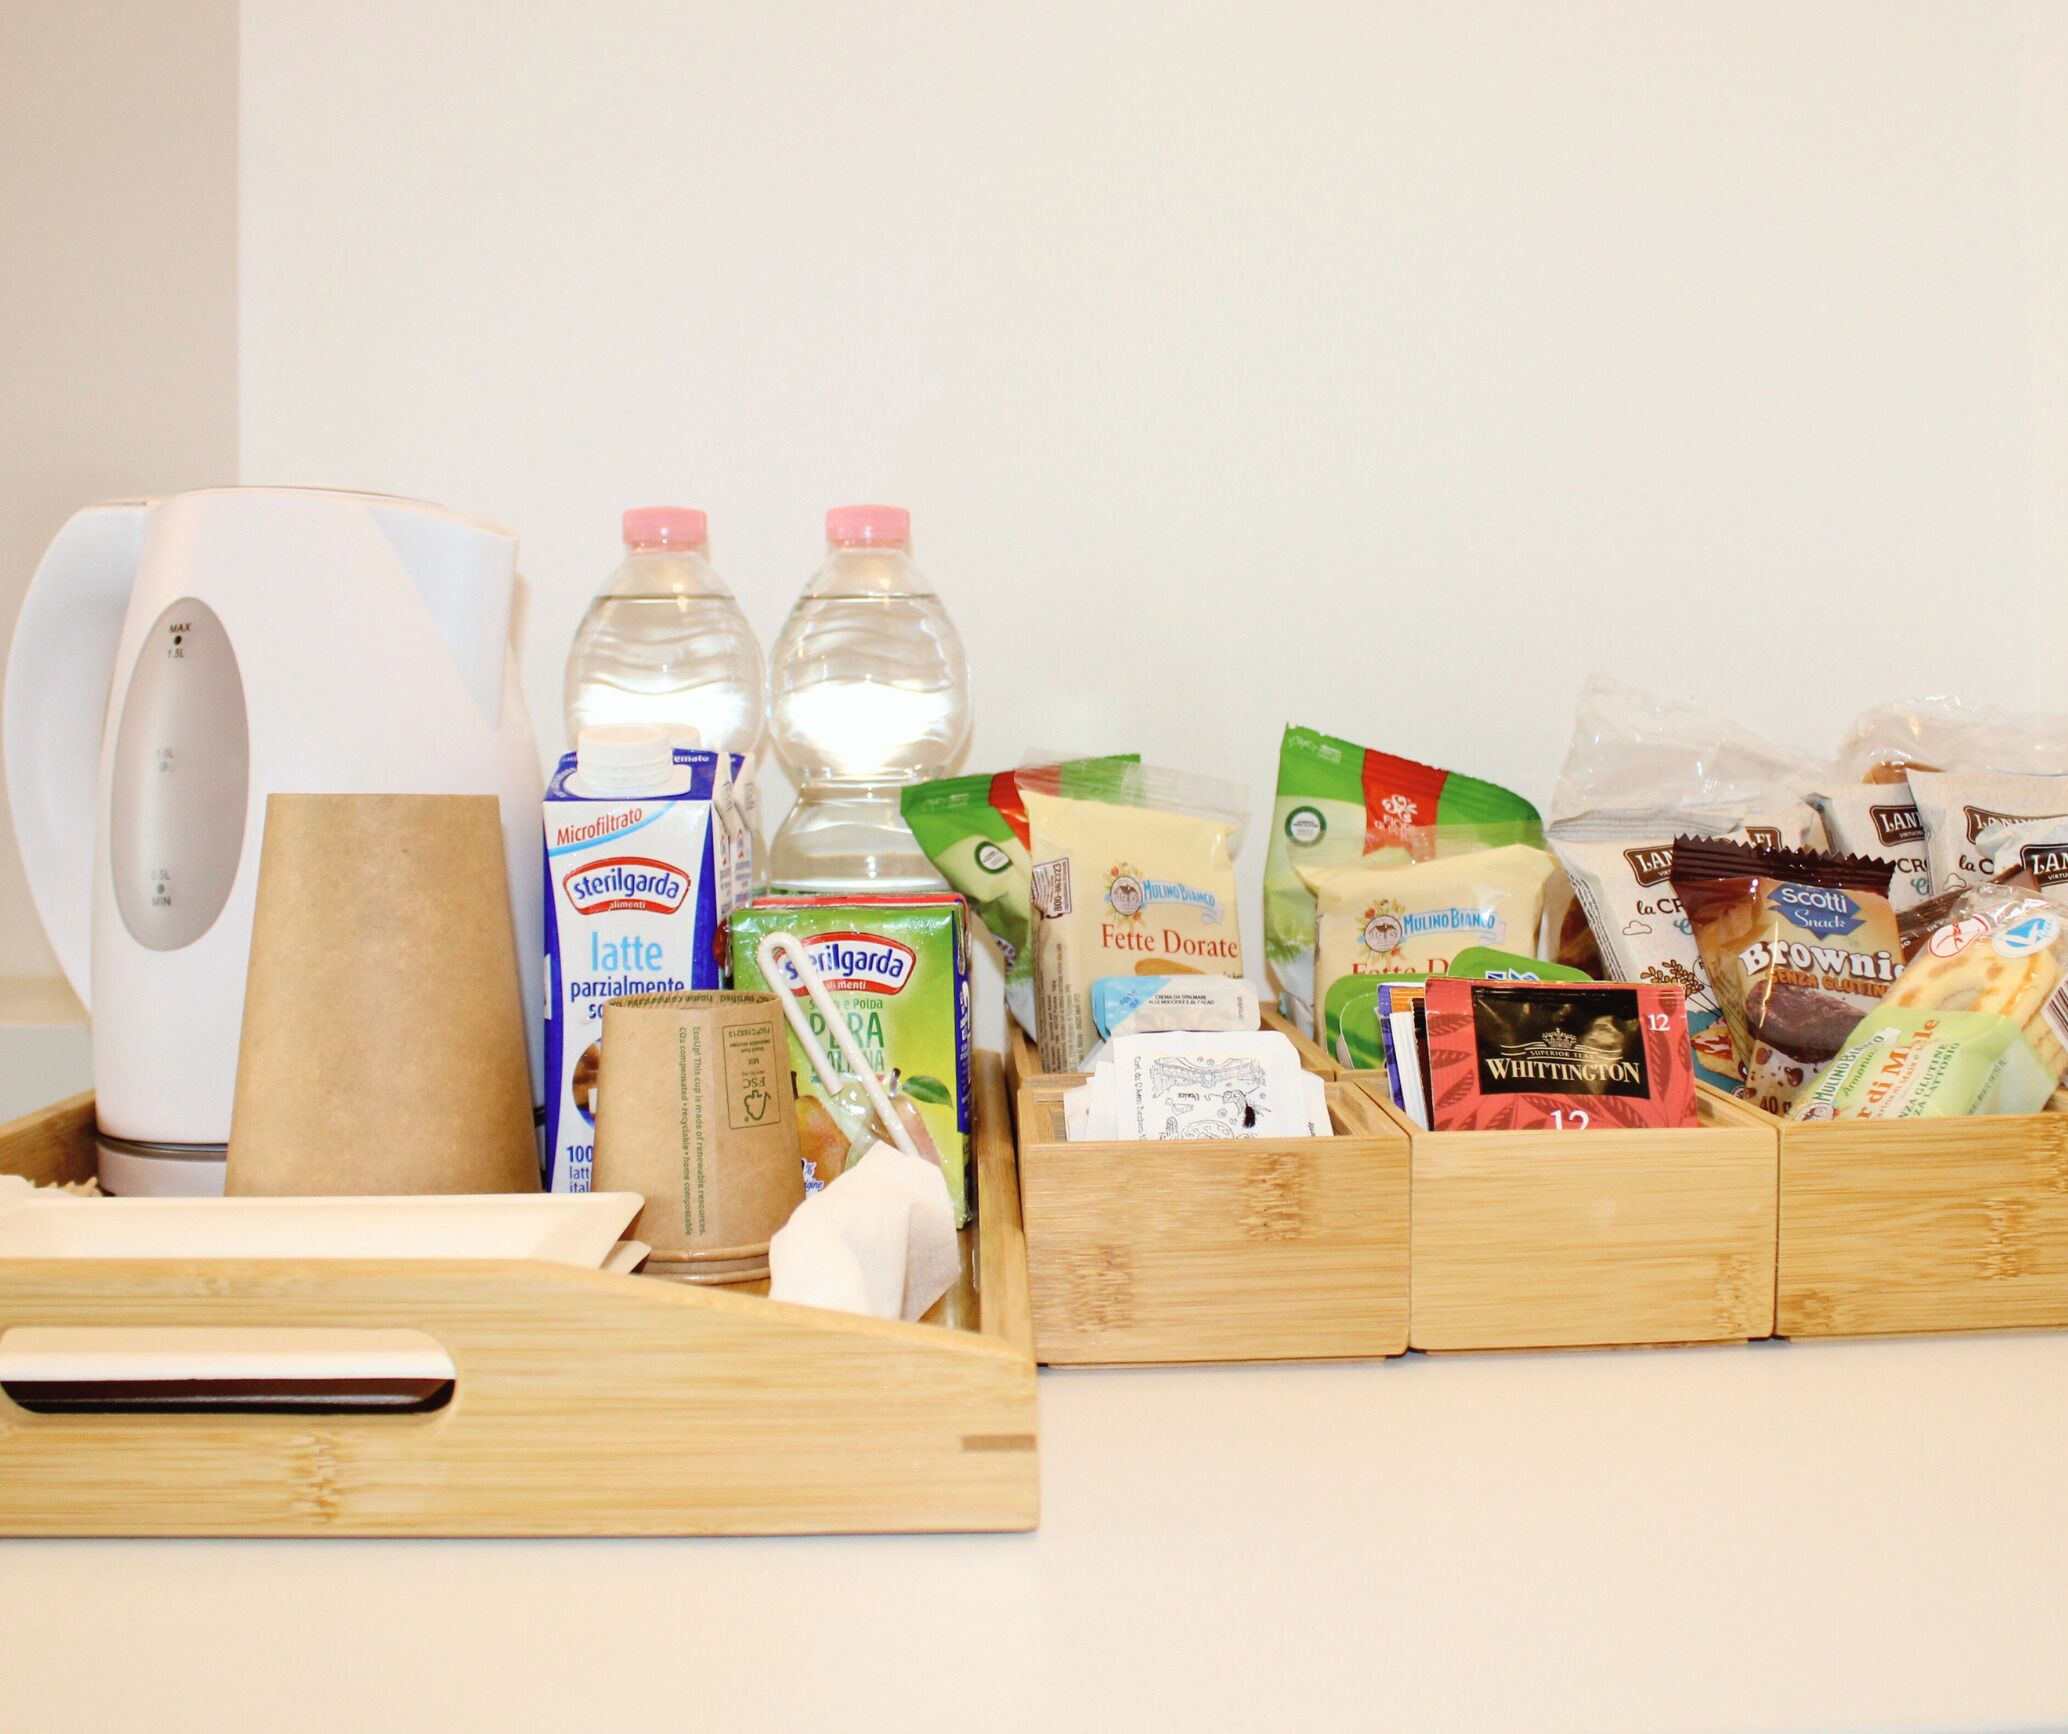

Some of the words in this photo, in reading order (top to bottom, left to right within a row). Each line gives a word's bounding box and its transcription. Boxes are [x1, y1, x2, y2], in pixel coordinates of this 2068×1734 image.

[169, 623, 192, 634] MAX
[557, 808, 642, 846] Microfiltrato
[573, 866, 680, 900] sterilgarda
[1142, 880, 1180, 902] MULINO
[1636, 898, 1657, 916] la
[1403, 911, 1449, 936] MULINO
[1794, 908, 1847, 929] Snack
[592, 931, 664, 971] latte
[1101, 923, 1155, 952] Fette
[1163, 929, 1238, 958] Dorate
[785, 943, 904, 980] srilgarda
[570, 975, 685, 1004] parzialmente
[1822, 975, 1888, 999] GLUTIN
[853, 998, 884, 1010] Polpa
[1648, 1013, 1670, 1032] 12
[1530, 1050, 1571, 1059] SUPERIOR
[1485, 1058, 1641, 1085] WHITTINGTON
[742, 1076, 766, 1089] FSC
[1550, 1110, 1590, 1130] 12
[567, 1145, 593, 1163] 100
[569, 1167, 591, 1181] latt
[683, 1157, 691, 1180] home
[570, 1182, 590, 1194] ital
